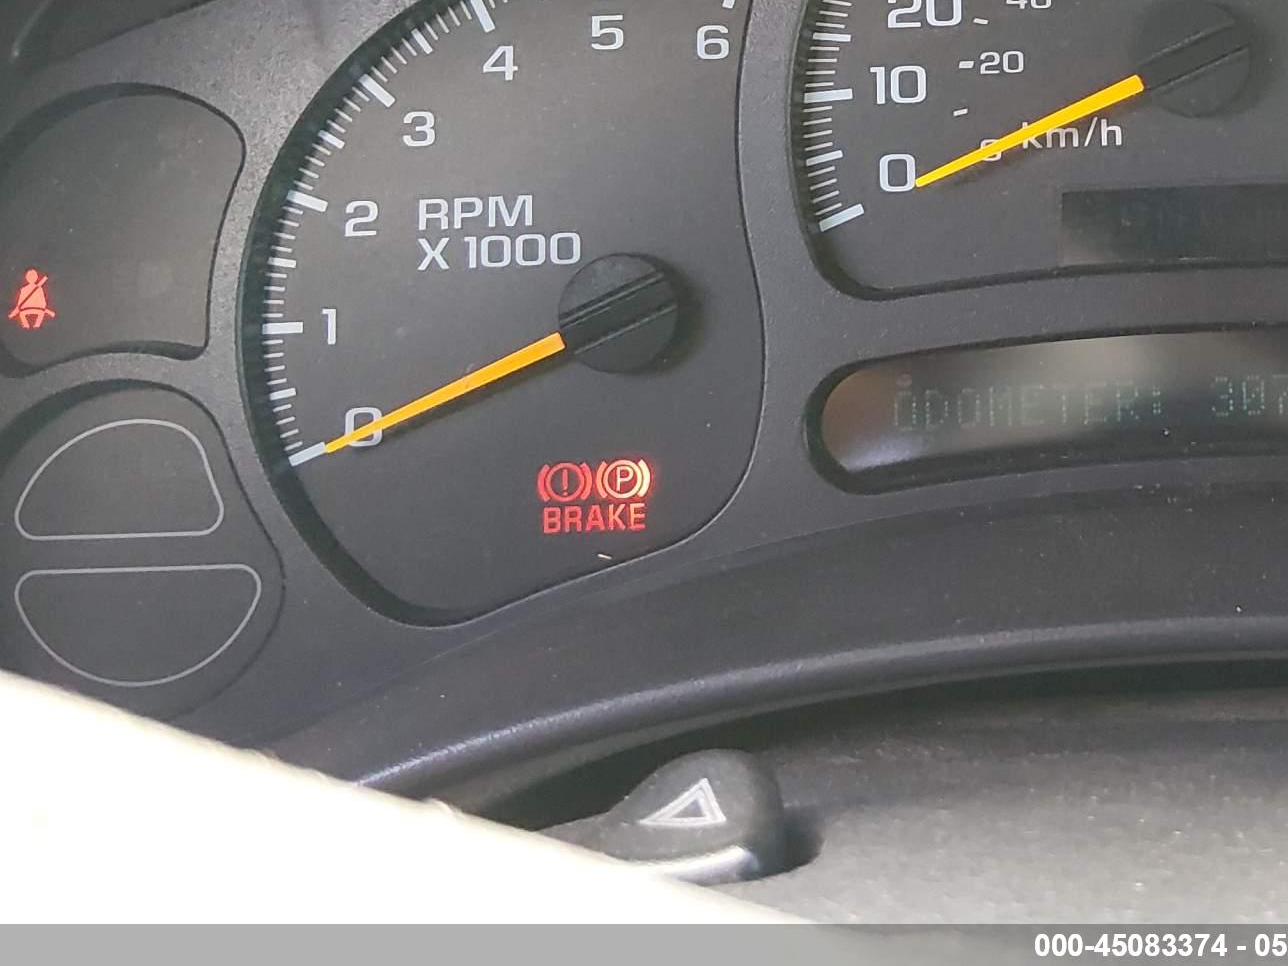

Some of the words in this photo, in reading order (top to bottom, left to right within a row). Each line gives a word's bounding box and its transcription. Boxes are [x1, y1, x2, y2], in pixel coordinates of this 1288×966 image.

[591, 14, 624, 50] 5
[696, 24, 730, 60] 6
[482, 45, 519, 81] 4
[979, 50, 1024, 75] 20
[869, 65, 927, 105] 10
[402, 111, 436, 147] 3
[1022, 117, 1123, 150] km/h
[879, 153, 917, 192] 0
[344, 200, 379, 237] 2
[418, 194, 534, 231] RPM
[417, 237, 450, 271] X
[463, 232, 581, 269] 1000
[321, 308, 337, 345] 1
[344, 407, 383, 447] 0
[543, 502, 647, 534] BRAKE
